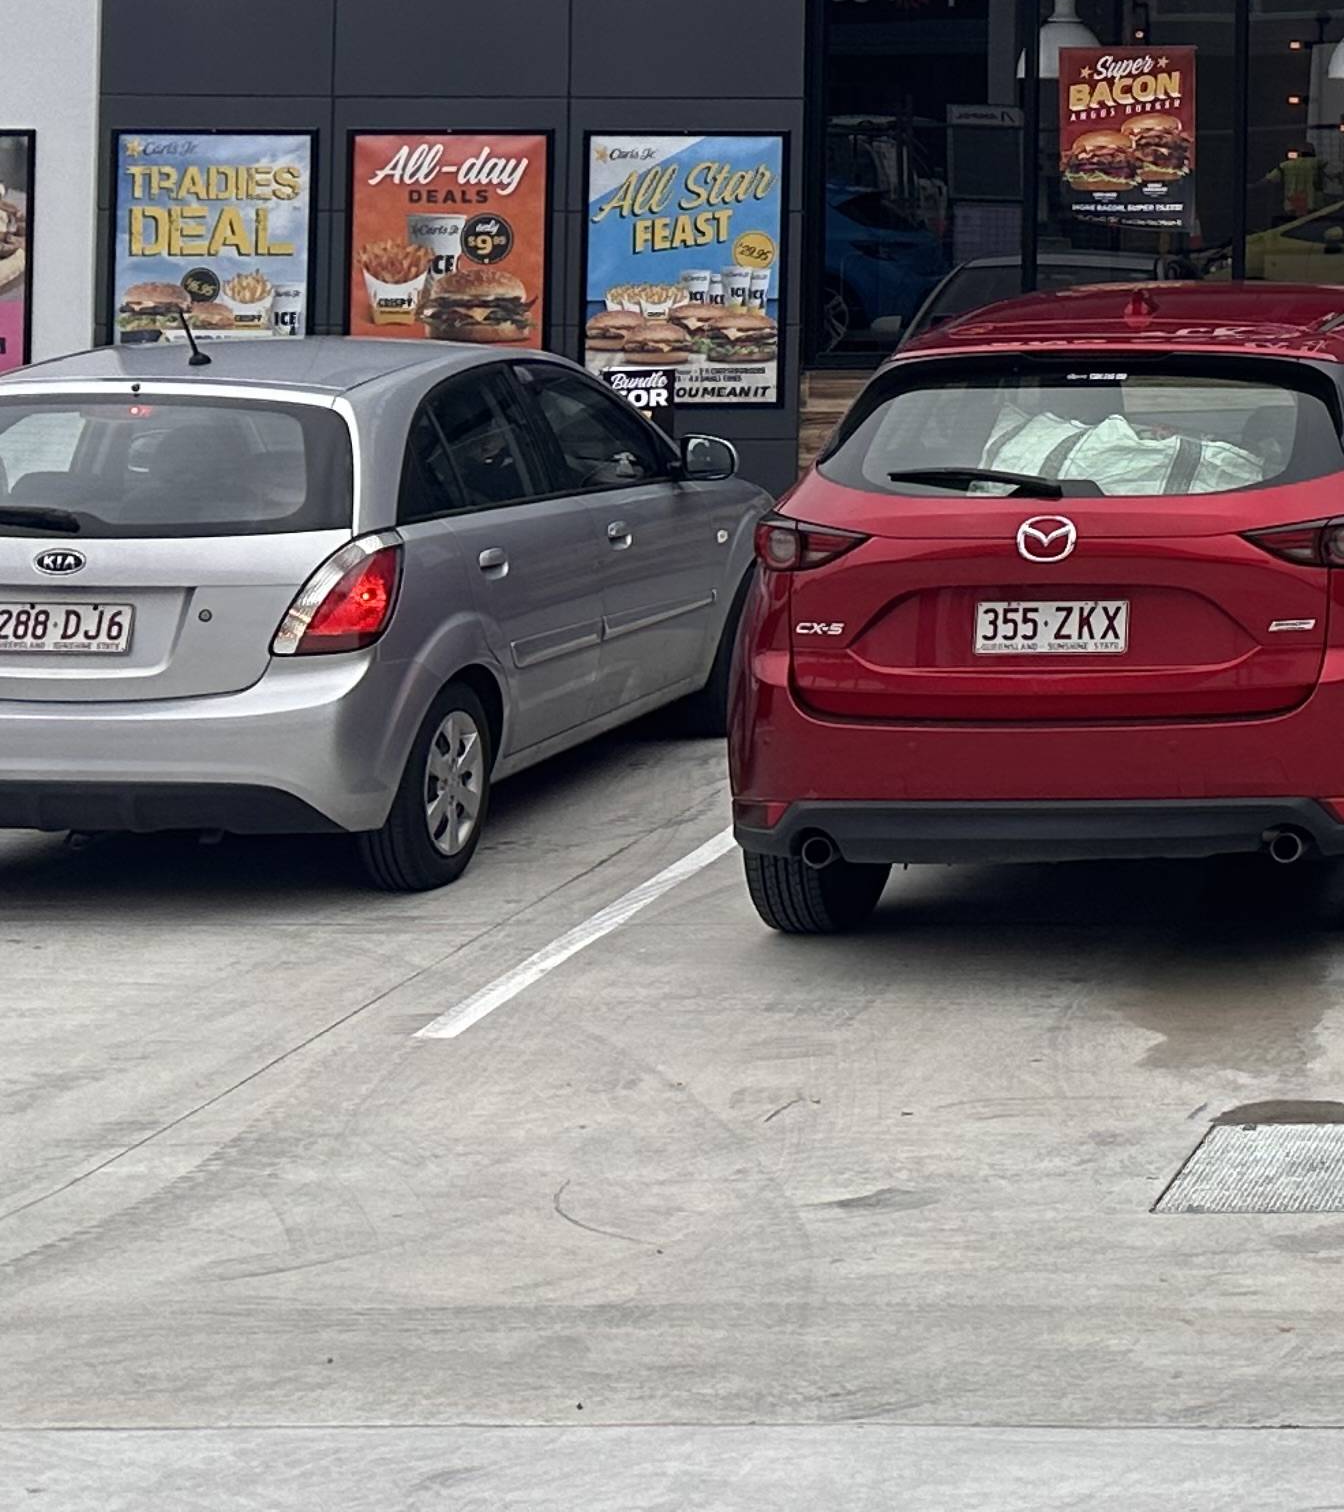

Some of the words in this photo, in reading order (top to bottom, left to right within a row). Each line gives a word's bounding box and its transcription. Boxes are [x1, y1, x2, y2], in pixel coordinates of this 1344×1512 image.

[1093, 55, 1154, 82] Super
[1069, 71, 1182, 111] BACON
[1070, 107, 1116, 122] ANGUS
[1125, 100, 1181, 115] BURGER
[368, 143, 529, 196] All-day
[126, 164, 302, 201] TRADIES
[591, 163, 680, 223] All
[679, 160, 776, 210] Star
[408, 189, 490, 205] DEALS
[128, 205, 295, 258] DEAL
[475, 219, 500, 235] only
[633, 209, 734, 255] FEAST
[273, 310, 298, 327] ICE
[610, 371, 668, 390] Bundle
[676, 386, 700, 398] OU
[701, 386, 751, 398] MEAN
[753, 385, 772, 398] IT
[42, 555, 77, 569] KIA
[795, 622, 845, 635] CX-5
